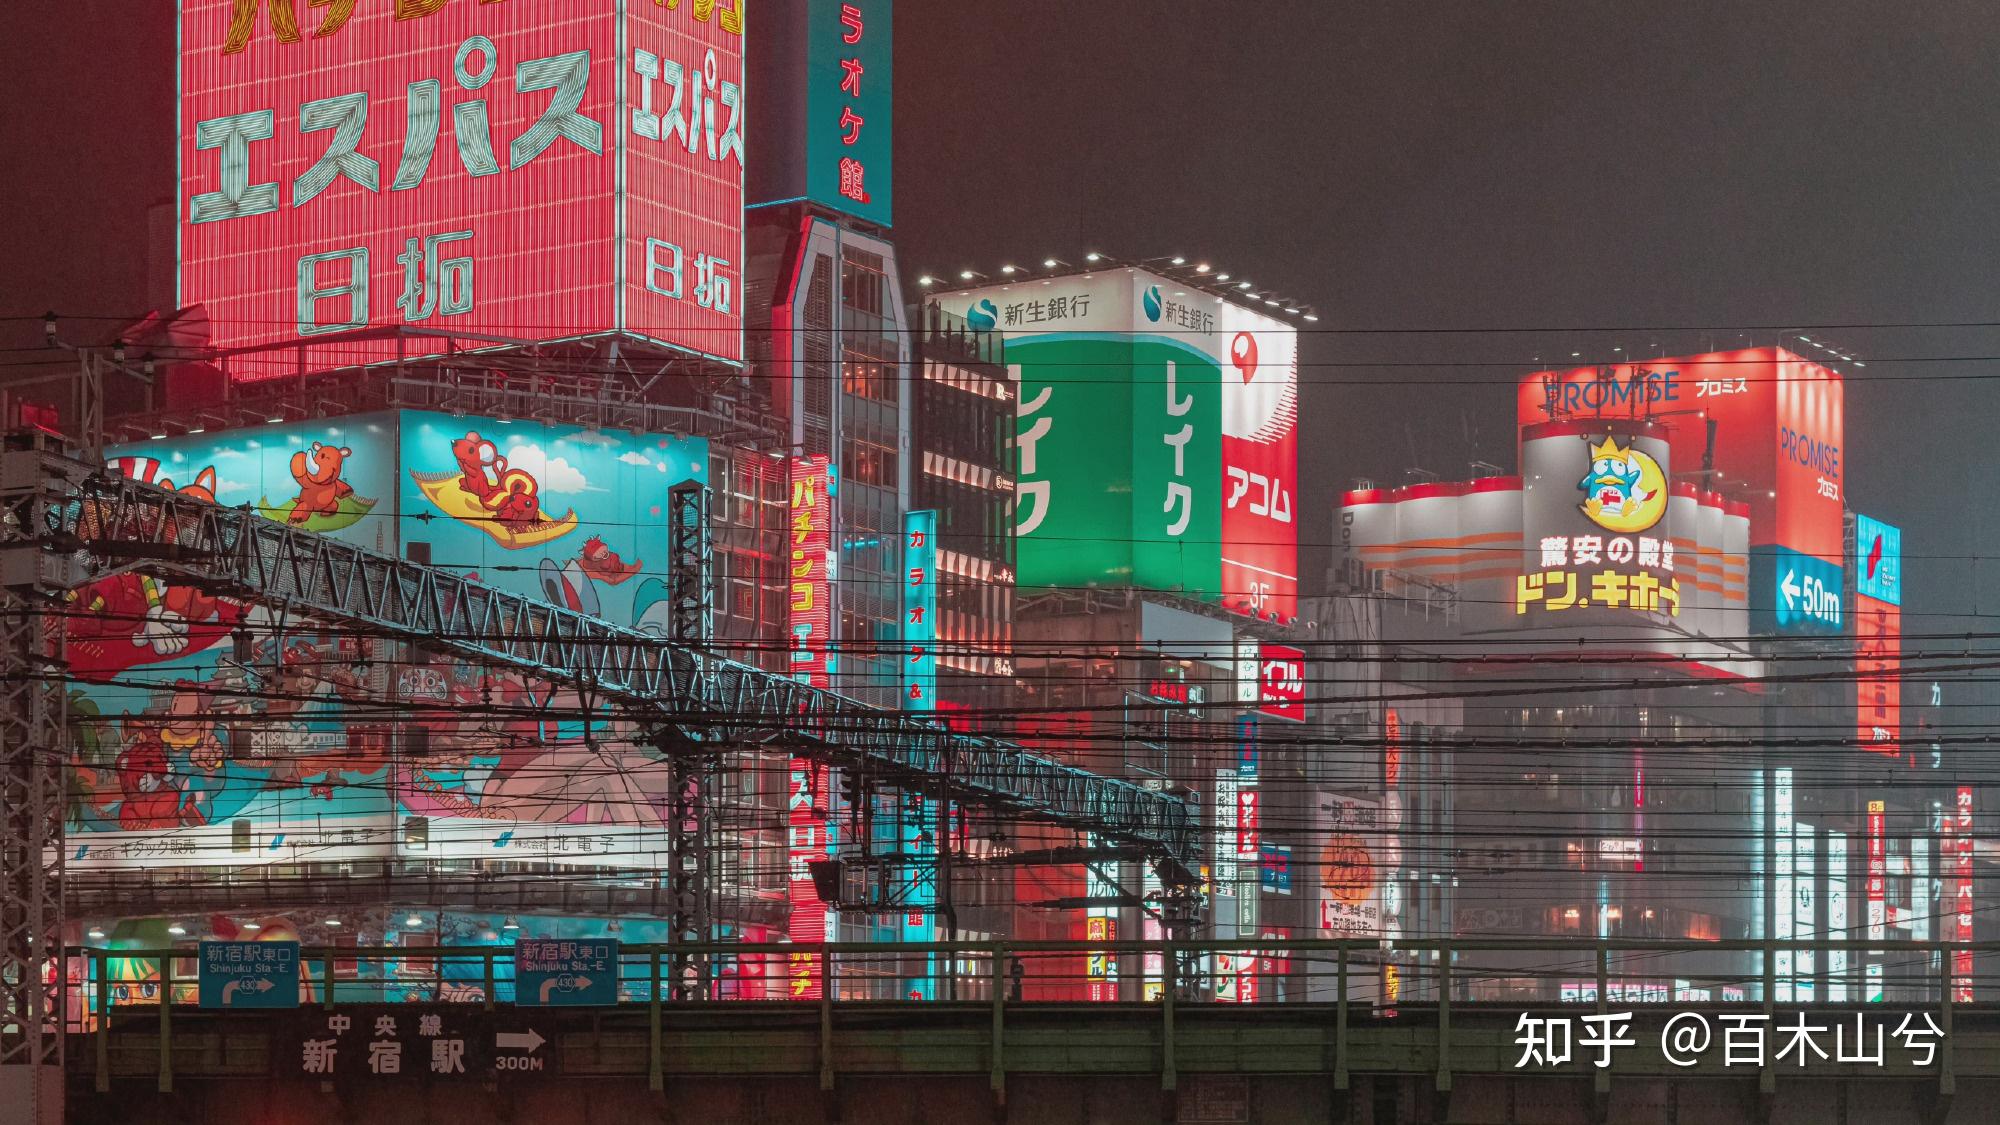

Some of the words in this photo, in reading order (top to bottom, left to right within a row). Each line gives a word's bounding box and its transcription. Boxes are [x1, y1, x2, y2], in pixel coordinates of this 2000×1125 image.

[632, 48, 743, 169] エスパス
[190, 35, 603, 224] エスパス
[298, 230, 475, 336] 日拓
[645, 236, 731, 314] 日拓
[1005, 294, 1090, 326] 新生銀行
[1165, 299, 1213, 336] 新生銀行
[1545, 371, 1680, 413] PROMISE
[1695, 377, 1748, 398] プロミス
[1781, 426, 1839, 478] PROMISE
[1227, 465, 1292, 523] アコム
[1817, 475, 1839, 501] プロミス
[792, 475, 815, 612] パチンコ
[1803, 575, 1840, 625] 50m
[1262, 659, 1303, 694] イフル
[554, 834, 615, 853] 北電子
[206, 944, 291, 962] 新宿駅東口
[209, 963, 252, 974] Shinjuku
[522, 943, 609, 960] 新宿駅東口
[526, 961, 568, 973] Shinjuku
[328, 1014, 442, 1036] 中央線
[303, 1038, 465, 1074] 新宿駅
[495, 1056, 543, 1071] 300M
